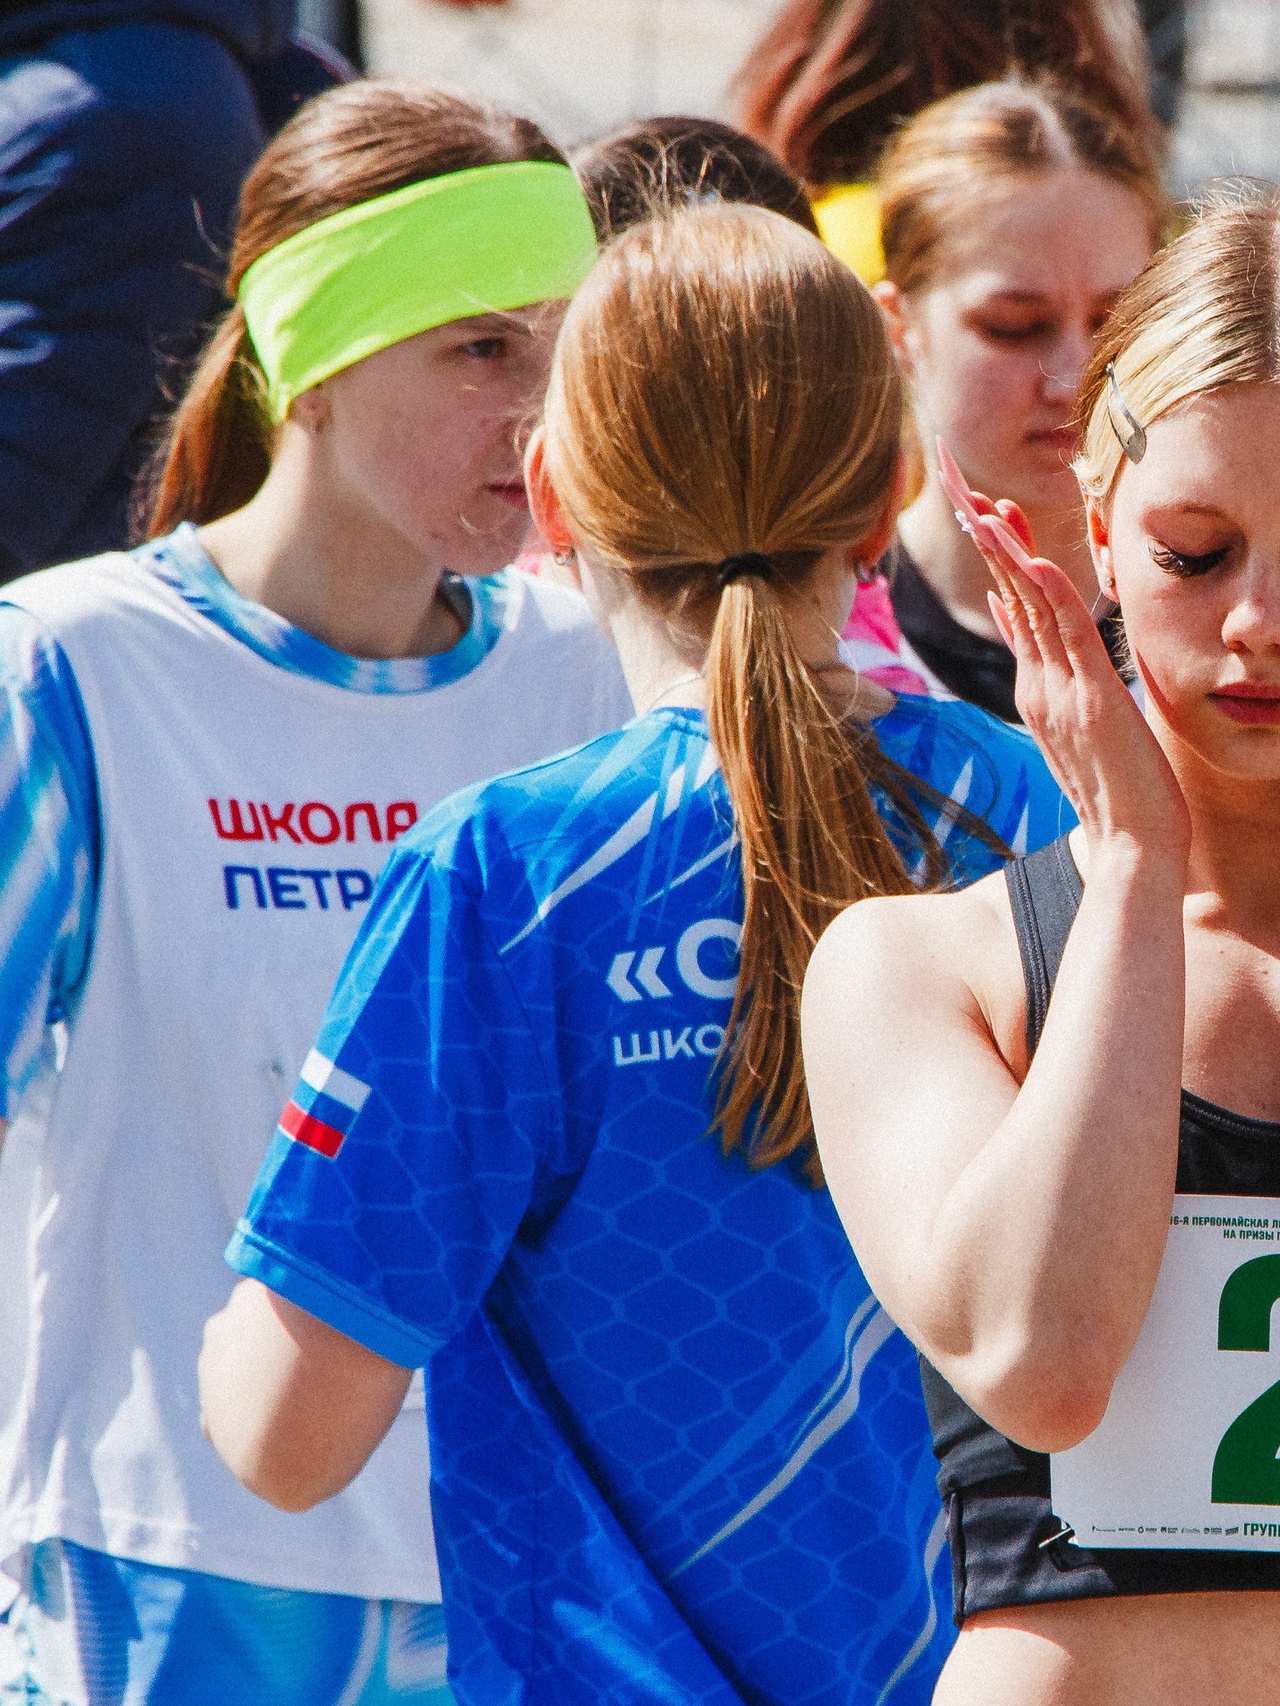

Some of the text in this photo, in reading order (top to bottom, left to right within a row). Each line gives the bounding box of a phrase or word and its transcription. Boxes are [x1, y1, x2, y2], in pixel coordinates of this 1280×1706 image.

[207, 798, 418, 845] ШКОЛА
[224, 865, 379, 911] ПЕТР
[612, 1022, 727, 1068] ШКО
[1192, 1216, 1269, 1228] ПЕРВОМАЙСКАЯ
[1223, 1229, 1236, 1240] НА
[1239, 1230, 1274, 1242] ПРИЗЫ
